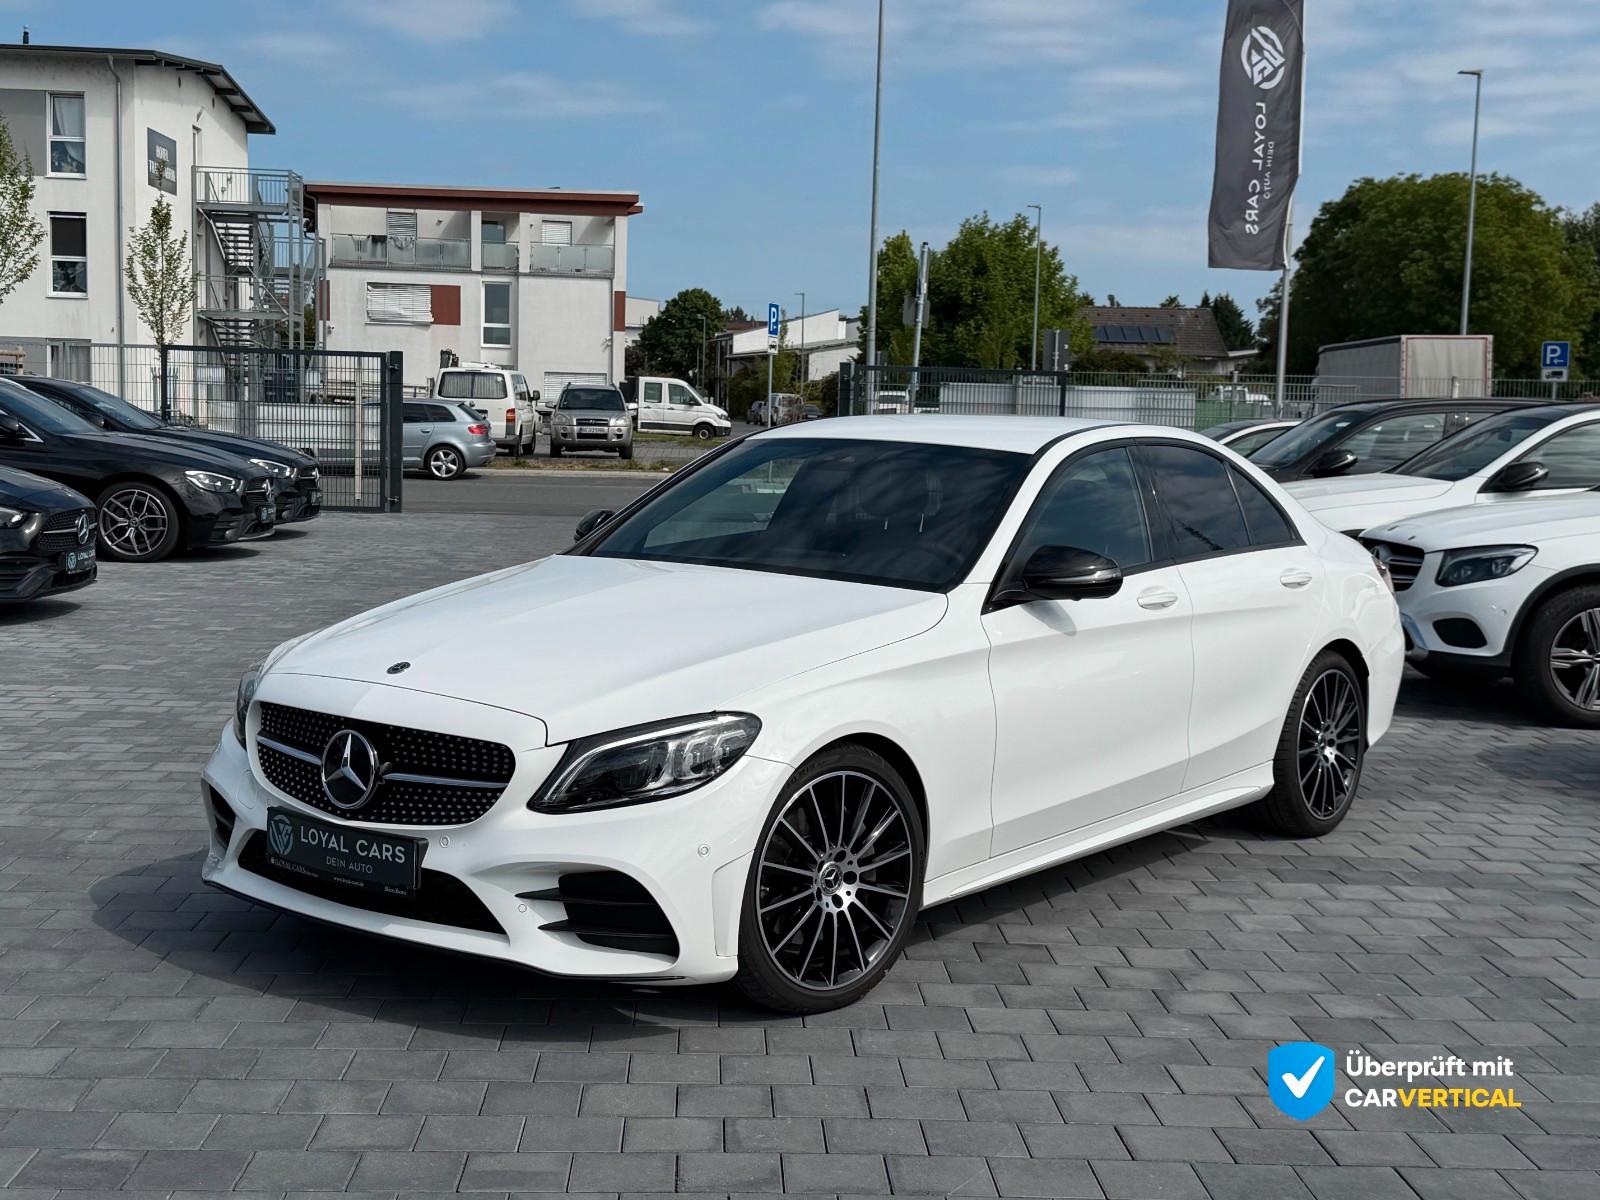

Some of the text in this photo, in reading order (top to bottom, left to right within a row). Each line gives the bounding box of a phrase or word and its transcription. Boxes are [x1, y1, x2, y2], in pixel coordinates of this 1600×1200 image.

[770, 306, 777, 331] P
[1546, 345, 1561, 365] P
[300, 825, 405, 864] LOYAL CARS
[326, 855, 346, 870] DEIN
[348, 861, 373, 874] AUTO
